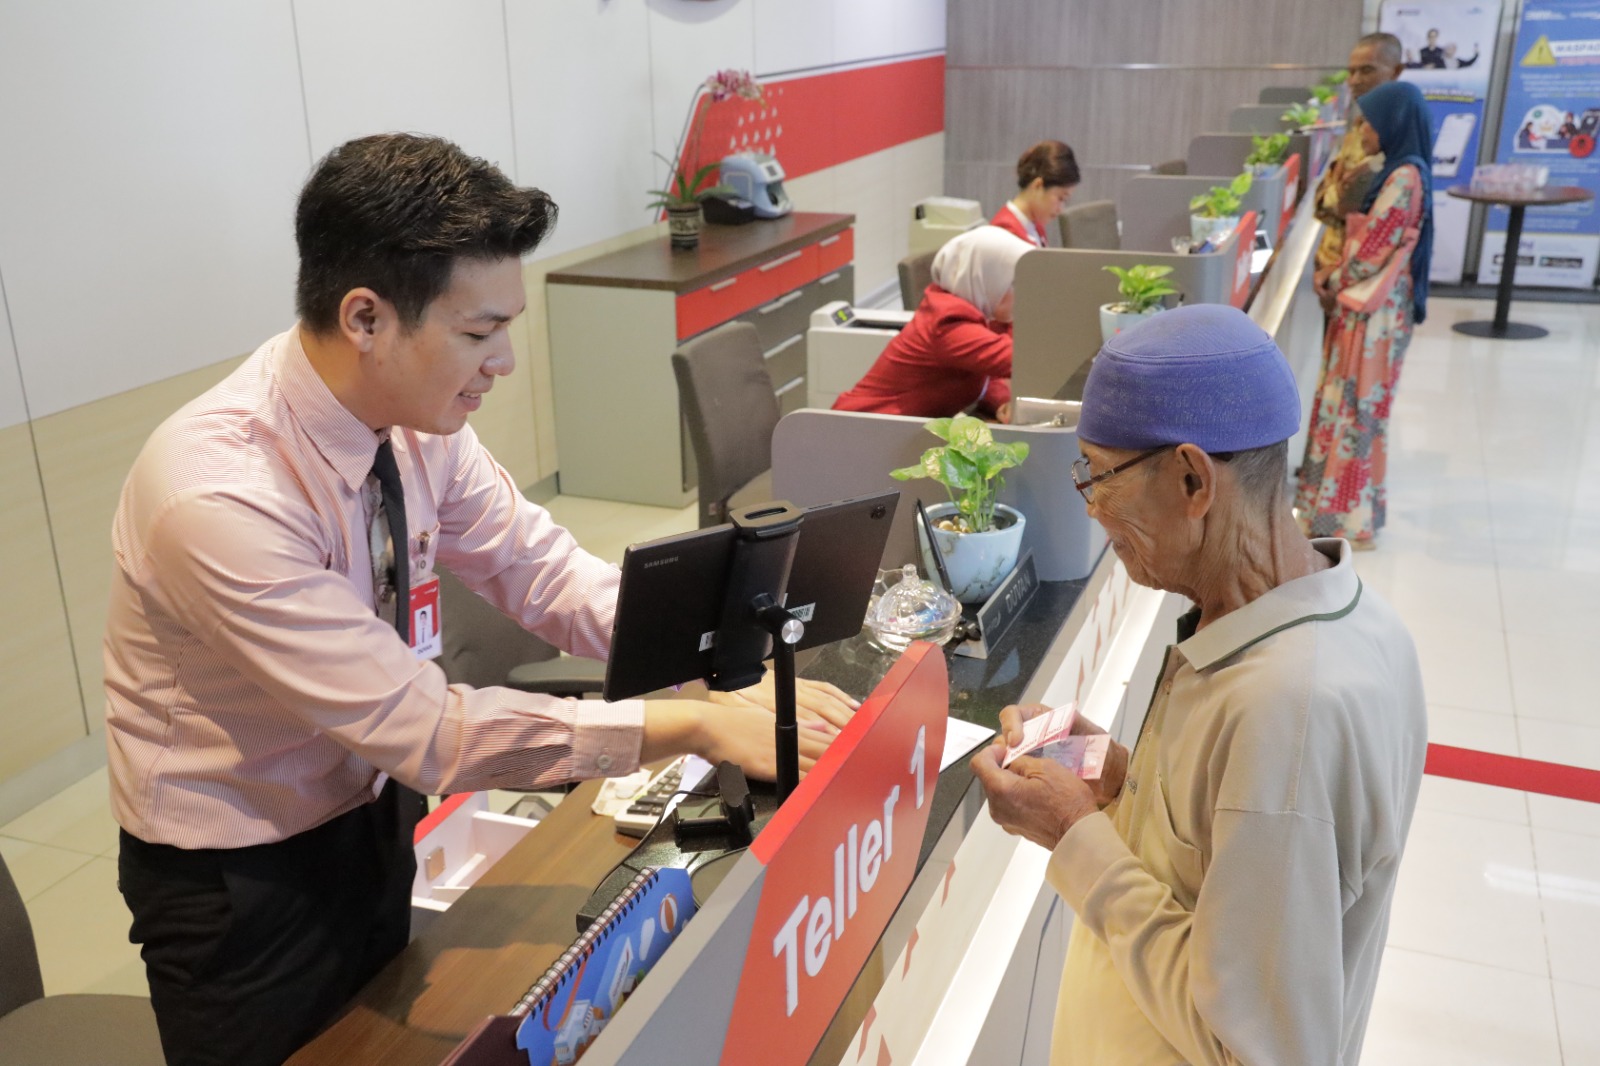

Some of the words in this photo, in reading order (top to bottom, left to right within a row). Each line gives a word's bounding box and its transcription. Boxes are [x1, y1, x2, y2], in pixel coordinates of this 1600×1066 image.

[644, 556, 678, 569] SAMSUNG
[773, 785, 900, 1017] Teller
[909, 724, 925, 809] 1
